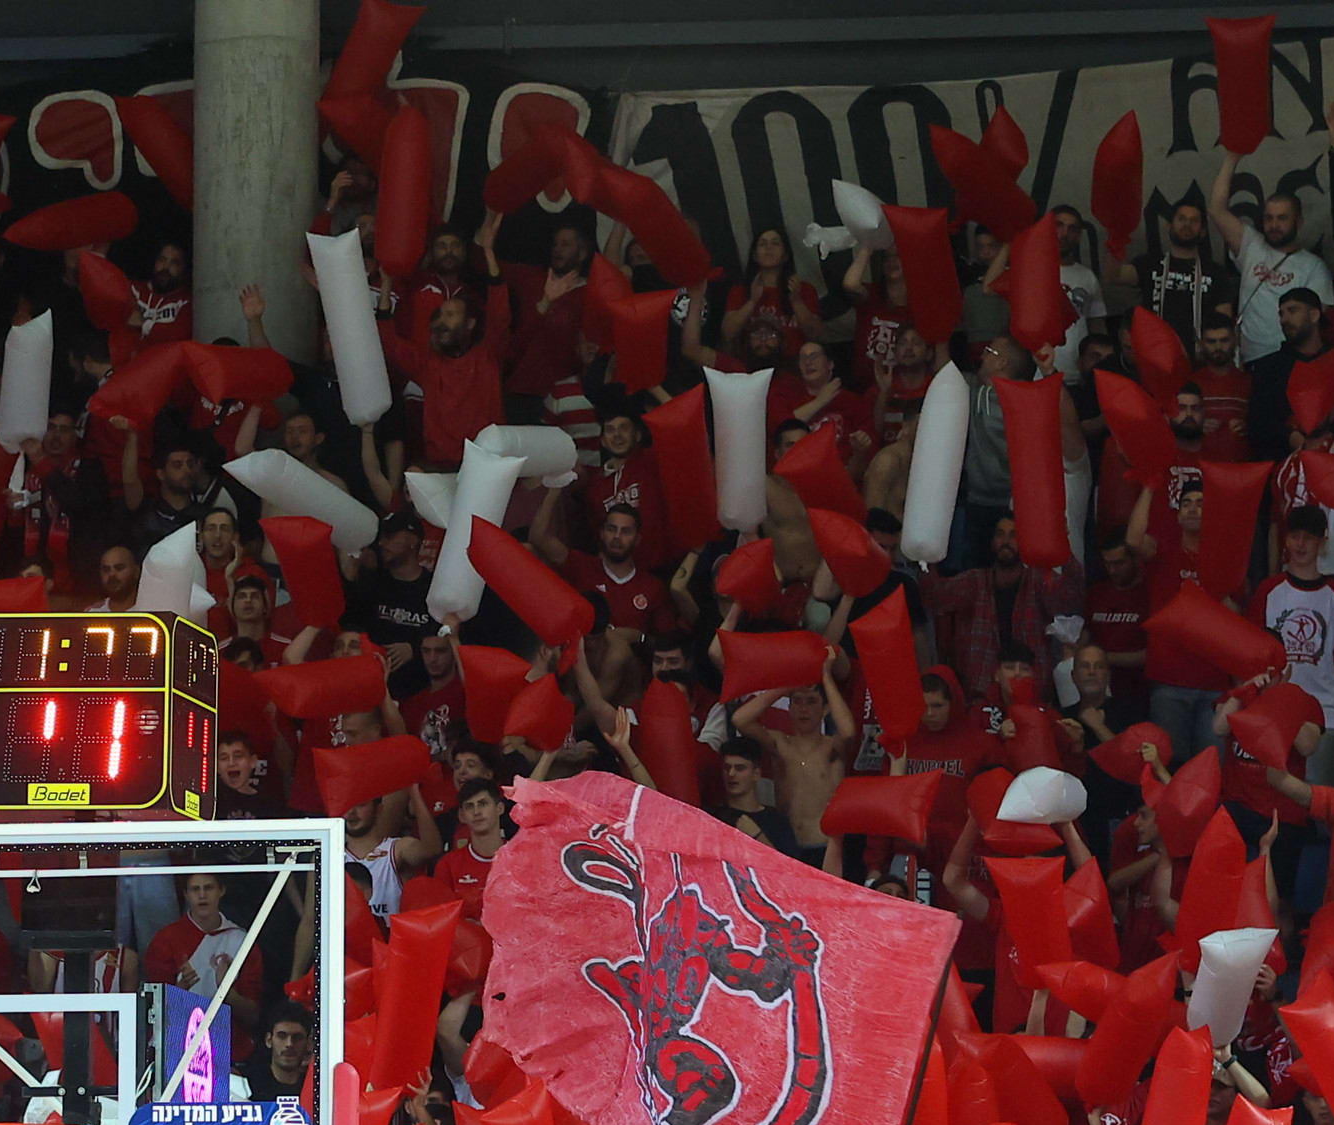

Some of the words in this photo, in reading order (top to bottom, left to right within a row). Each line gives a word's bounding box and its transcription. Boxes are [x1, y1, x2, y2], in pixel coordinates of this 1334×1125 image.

[34, 786, 87, 804] Bodet
[151, 1104, 218, 1124] המדינה
[223, 1104, 263, 1124] גביע
